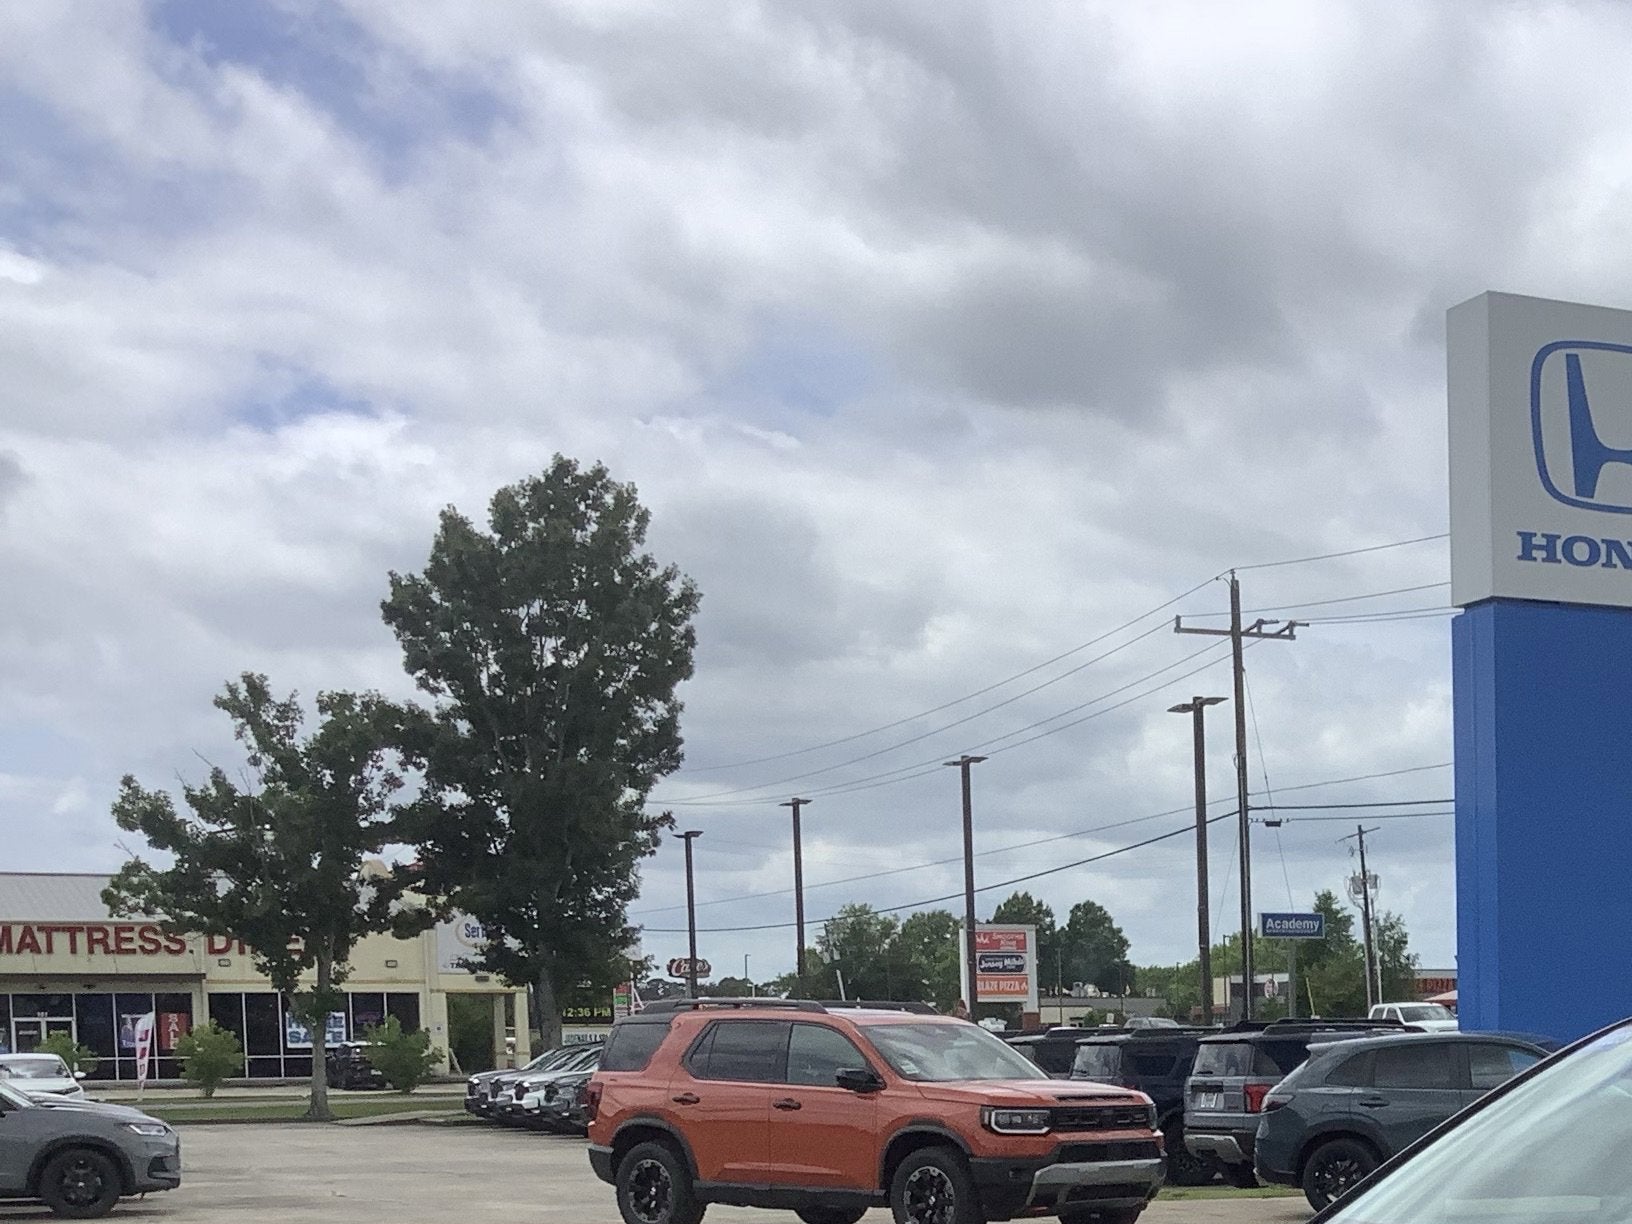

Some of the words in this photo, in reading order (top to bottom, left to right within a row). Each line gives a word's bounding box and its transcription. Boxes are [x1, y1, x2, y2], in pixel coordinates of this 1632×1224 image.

[1265, 917, 1320, 932] Academy
[0, 924, 187, 956] MATTRESS
[1000, 980, 1020, 991] PIZZA
[562, 1007, 591, 1018] 12:36
[593, 1007, 611, 1017] PM
